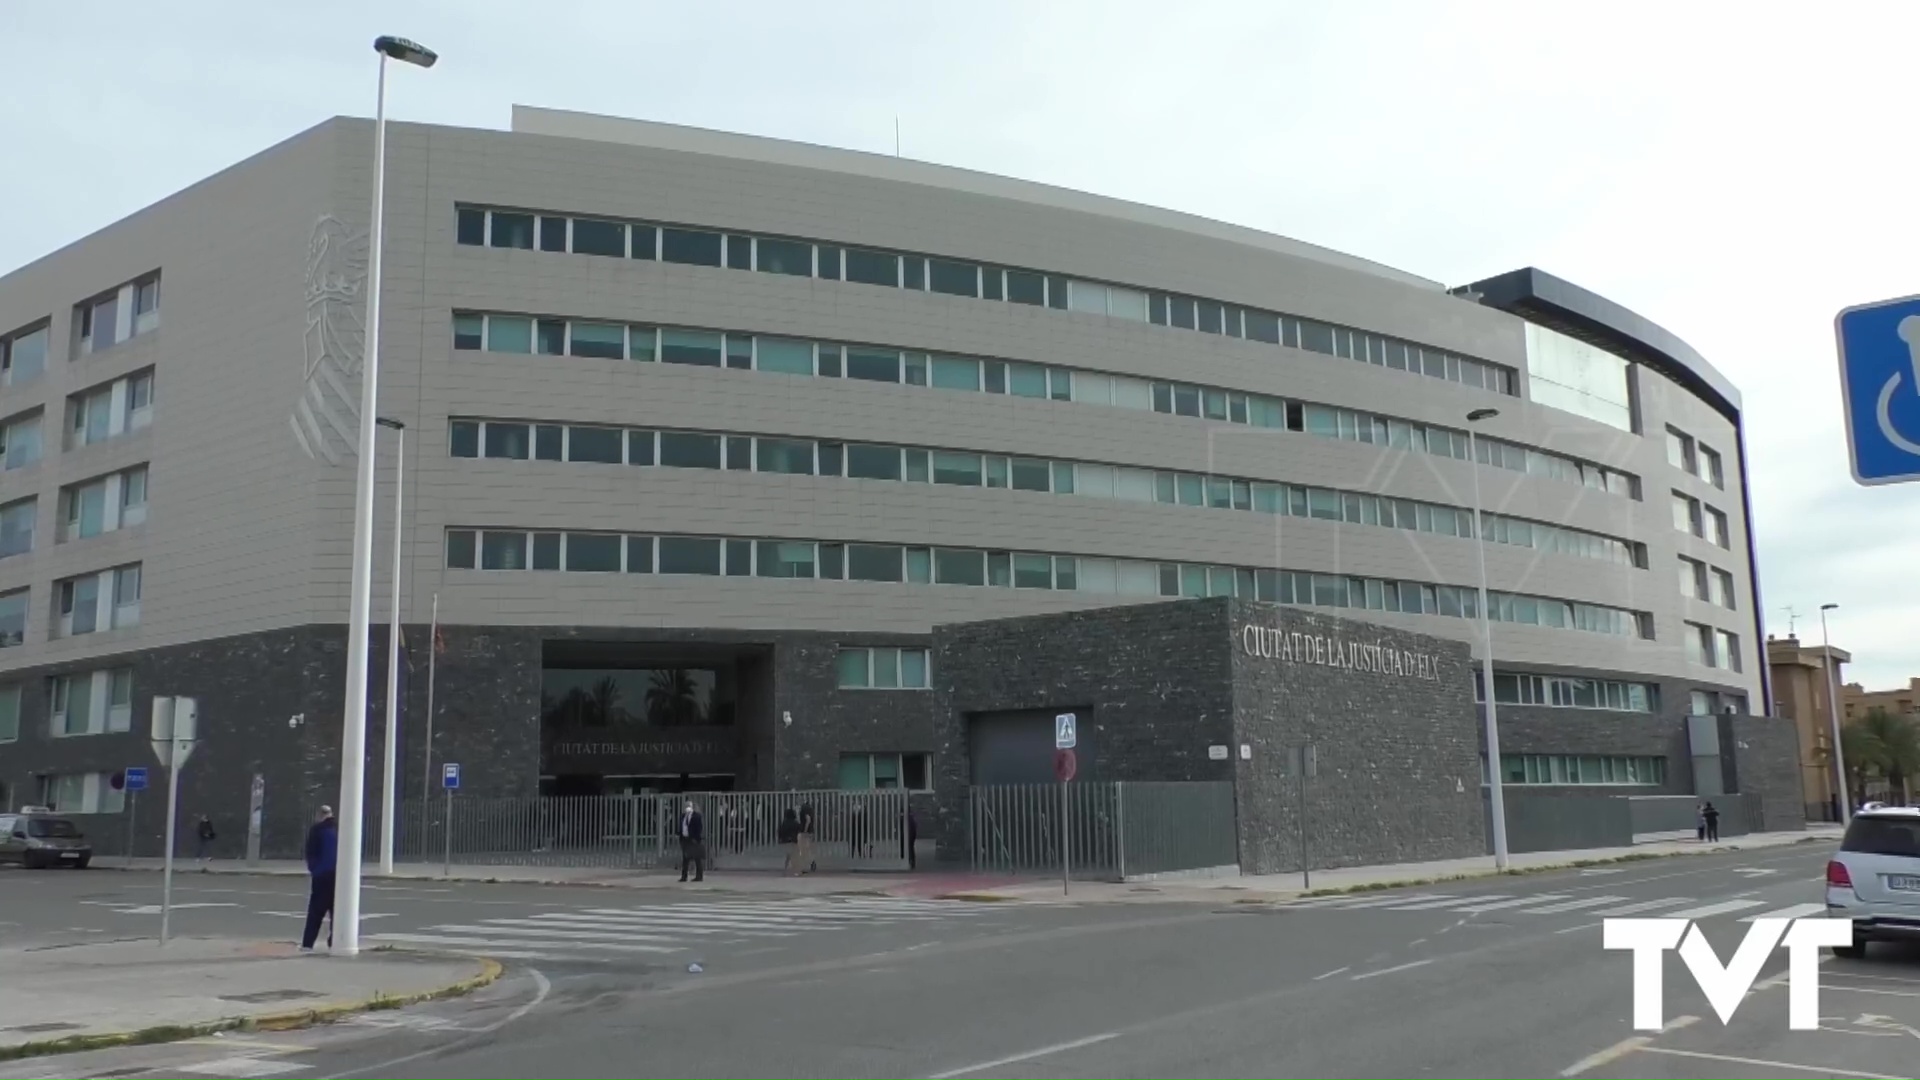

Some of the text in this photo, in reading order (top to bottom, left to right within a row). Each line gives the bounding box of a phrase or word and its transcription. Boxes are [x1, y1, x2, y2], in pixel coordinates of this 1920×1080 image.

[1243, 624, 1301, 662] CIUTAT
[1304, 635, 1325, 665] DE
[1328, 638, 1347, 669] LA
